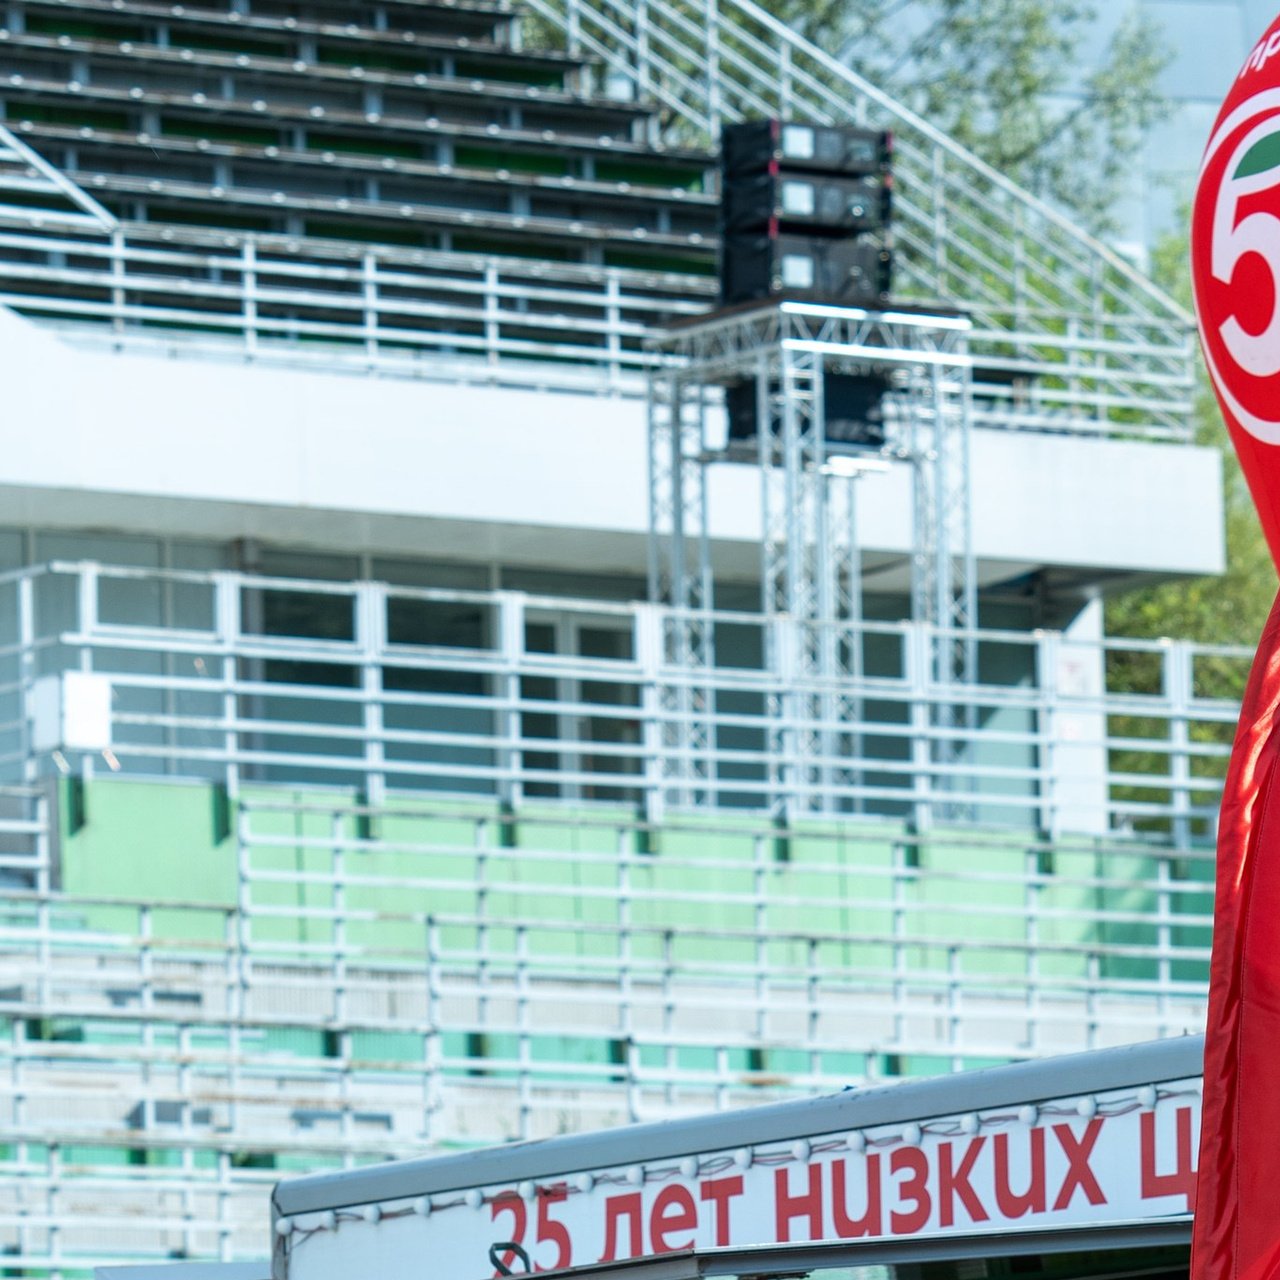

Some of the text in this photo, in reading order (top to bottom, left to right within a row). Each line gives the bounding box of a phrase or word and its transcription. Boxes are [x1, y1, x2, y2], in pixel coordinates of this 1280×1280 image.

[489, 1106, 1196, 1278] 25 лет низких ц
